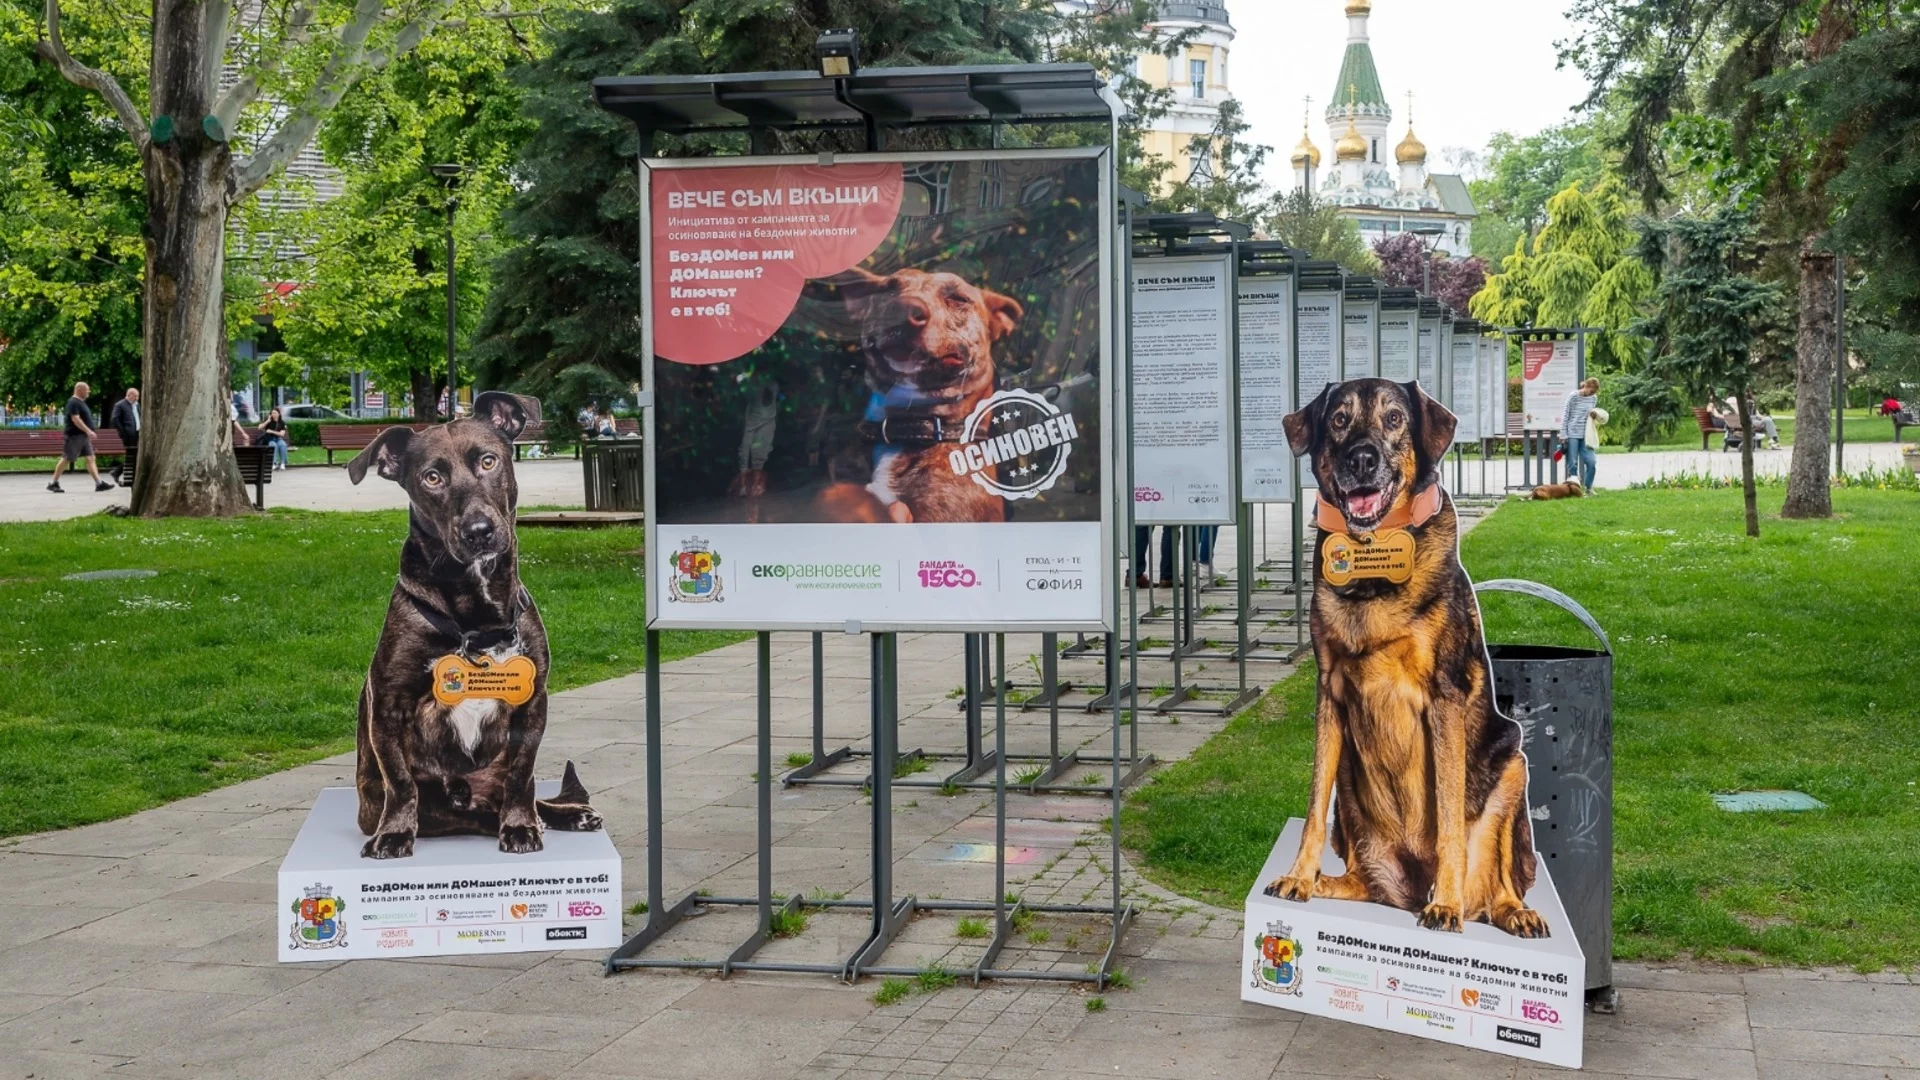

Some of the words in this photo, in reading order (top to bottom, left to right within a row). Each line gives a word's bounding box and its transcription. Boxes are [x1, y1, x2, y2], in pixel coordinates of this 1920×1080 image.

[668, 190, 726, 209] ВЕЧЕ
[731, 188, 782, 207] СЪМ
[789, 185, 879, 206] ВКЪЩИ
[668, 217, 735, 227] Инициатива
[752, 215, 816, 224] кампанията
[818, 214, 830, 222] за
[668, 231, 737, 240] осиновяване
[739, 230, 752, 238] на
[754, 228, 806, 239] бездомни
[809, 227, 857, 236] животни
[669, 249, 758, 264] БезДОМен
[762, 249, 794, 260] или
[670, 266, 763, 282] ДОМашен?
[1138, 277, 1159, 285] ВЕЧЕ
[1160, 276, 1181, 284] СЪМ
[670, 287, 737, 298] Ключът
[671, 306, 681, 317] е
[683, 306, 693, 316] в
[696, 302, 731, 316] теб!
[949, 412, 1079, 476] ОСИНОВЕН
[919, 561, 957, 569] БАНДАТА
[752, 564, 881, 582] екоравновесие
[1026, 578, 1082, 590] СОФИЯ
[361, 882, 425, 893] БезДОМен
[427, 882, 449, 890] или
[451, 878, 516, 890] ДОМашен?
[519, 877, 565, 886] Ключът
[584, 874, 608, 883] теб!
[428, 892, 494, 900] осиновяване
[513, 889, 562, 898] бездомни
[381, 930, 408, 938] НОВИТЕ
[377, 939, 414, 948] РОДИТЕЛИ
[1317, 931, 1377, 950] БезДОМен
[1379, 944, 1401, 954] или
[1403, 947, 1470, 967] ДОМашен?
[1471, 958, 1520, 976] Ключът
[1522, 970, 1530, 978] е
[1532, 971, 1539, 979] в
[1541, 973, 1568, 985] теб!
[1316, 945, 1363, 960] кампания
[1380, 957, 1445, 975] осиновяване
[1449, 970, 1461, 978] на
[1464, 971, 1516, 988] бездомни
[1520, 983, 1568, 998] животни
[1334, 988, 1359, 1000] НОВИТЕ
[1329, 997, 1365, 1012] РОДИТЕЛИ
[1499, 1029, 1538, 1045] обекти;
